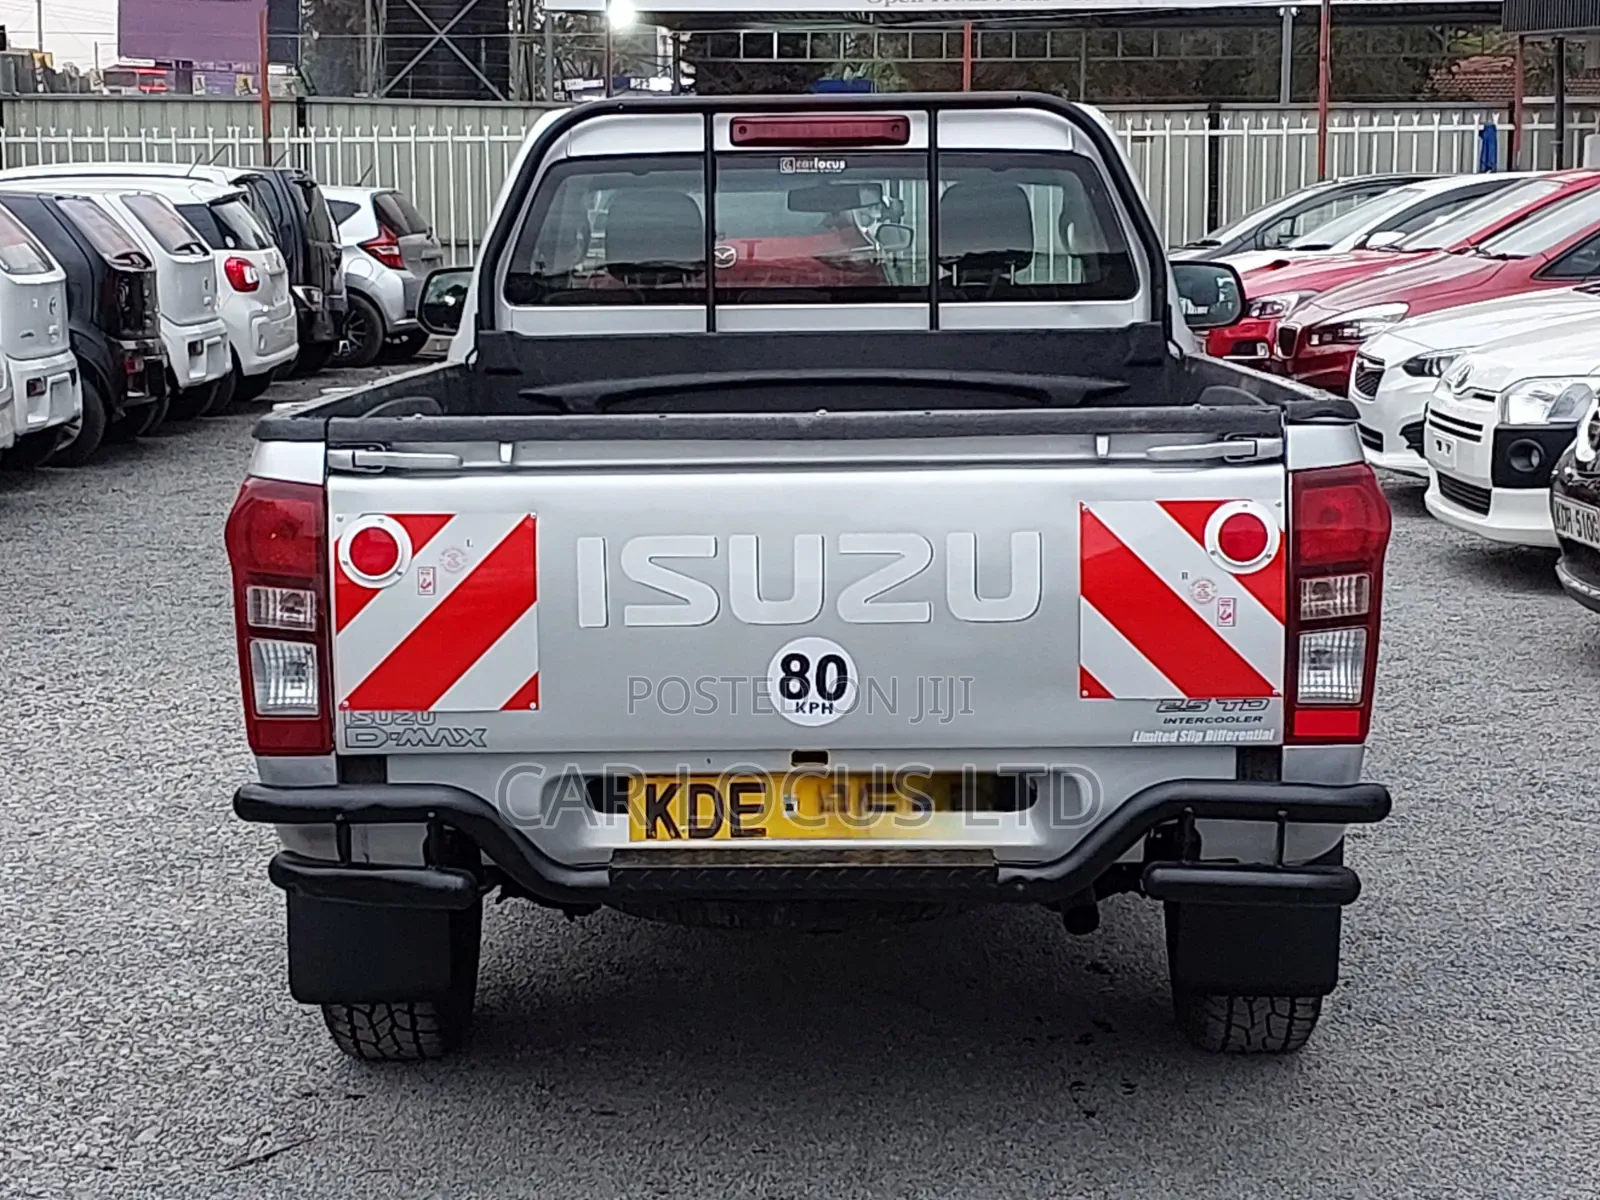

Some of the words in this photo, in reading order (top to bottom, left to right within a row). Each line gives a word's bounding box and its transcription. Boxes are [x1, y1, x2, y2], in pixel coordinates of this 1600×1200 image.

[576, 531, 1043, 628] ISUZU
[778, 652, 849, 702] 80
[794, 701, 835, 715] KPH
[1216, 698, 1271, 712] TD
[344, 711, 436, 726] ISUZU
[1163, 715, 1264, 725] INTERCOOLER
[345, 726, 488, 749] D-MAX
[1132, 730, 1178, 743] Limited
[1179, 730, 1204, 744] Slip
[1204, 728, 1274, 742] Differential
[645, 782, 767, 840] KDE
